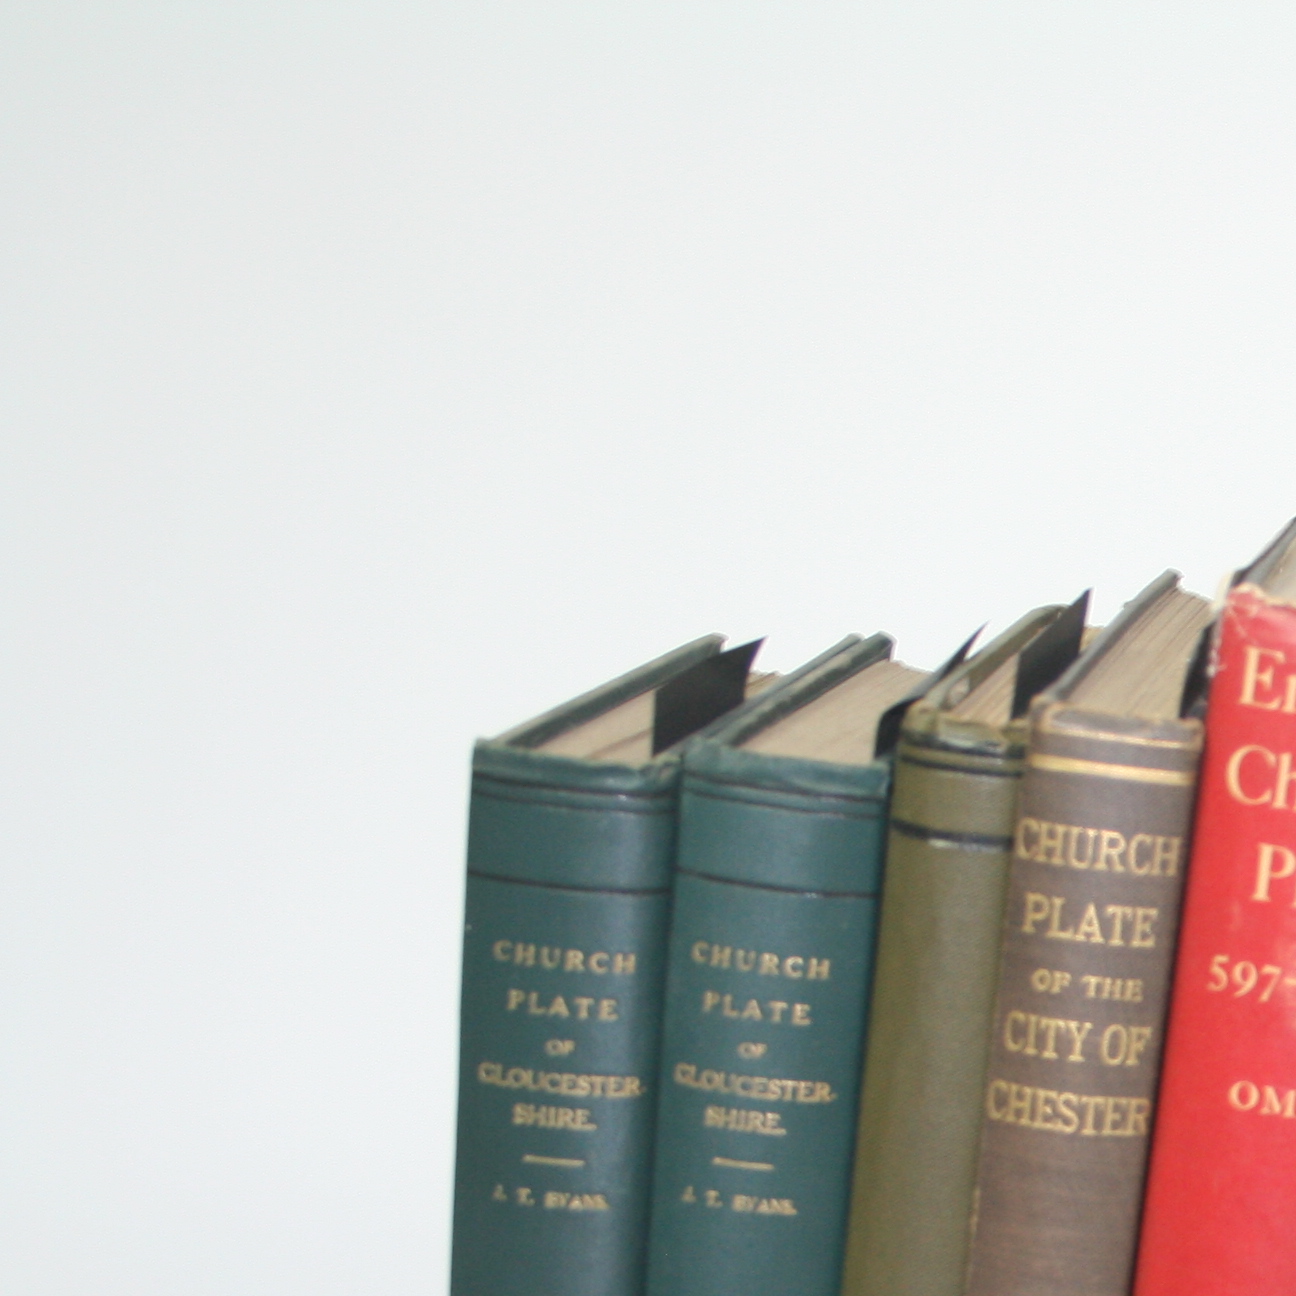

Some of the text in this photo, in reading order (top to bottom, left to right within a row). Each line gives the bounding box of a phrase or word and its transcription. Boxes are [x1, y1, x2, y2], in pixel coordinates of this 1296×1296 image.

[1015, 817, 1184, 877] CHURCH
[1021, 891, 1159, 949] PLATE
[493, 939, 638, 975] CHURCH
[692, 940, 832, 981] CHURCH
[1031, 968, 1144, 1002] OF THE
[507, 989, 619, 1022] PLATE
[704, 991, 813, 1026] PLATE
[545, 1038, 576, 1056] OF
[738, 1042, 768, 1059] OF
[1005, 1010, 1152, 1066] CITY OF
[987, 1079, 1150, 1137] CHESTER
